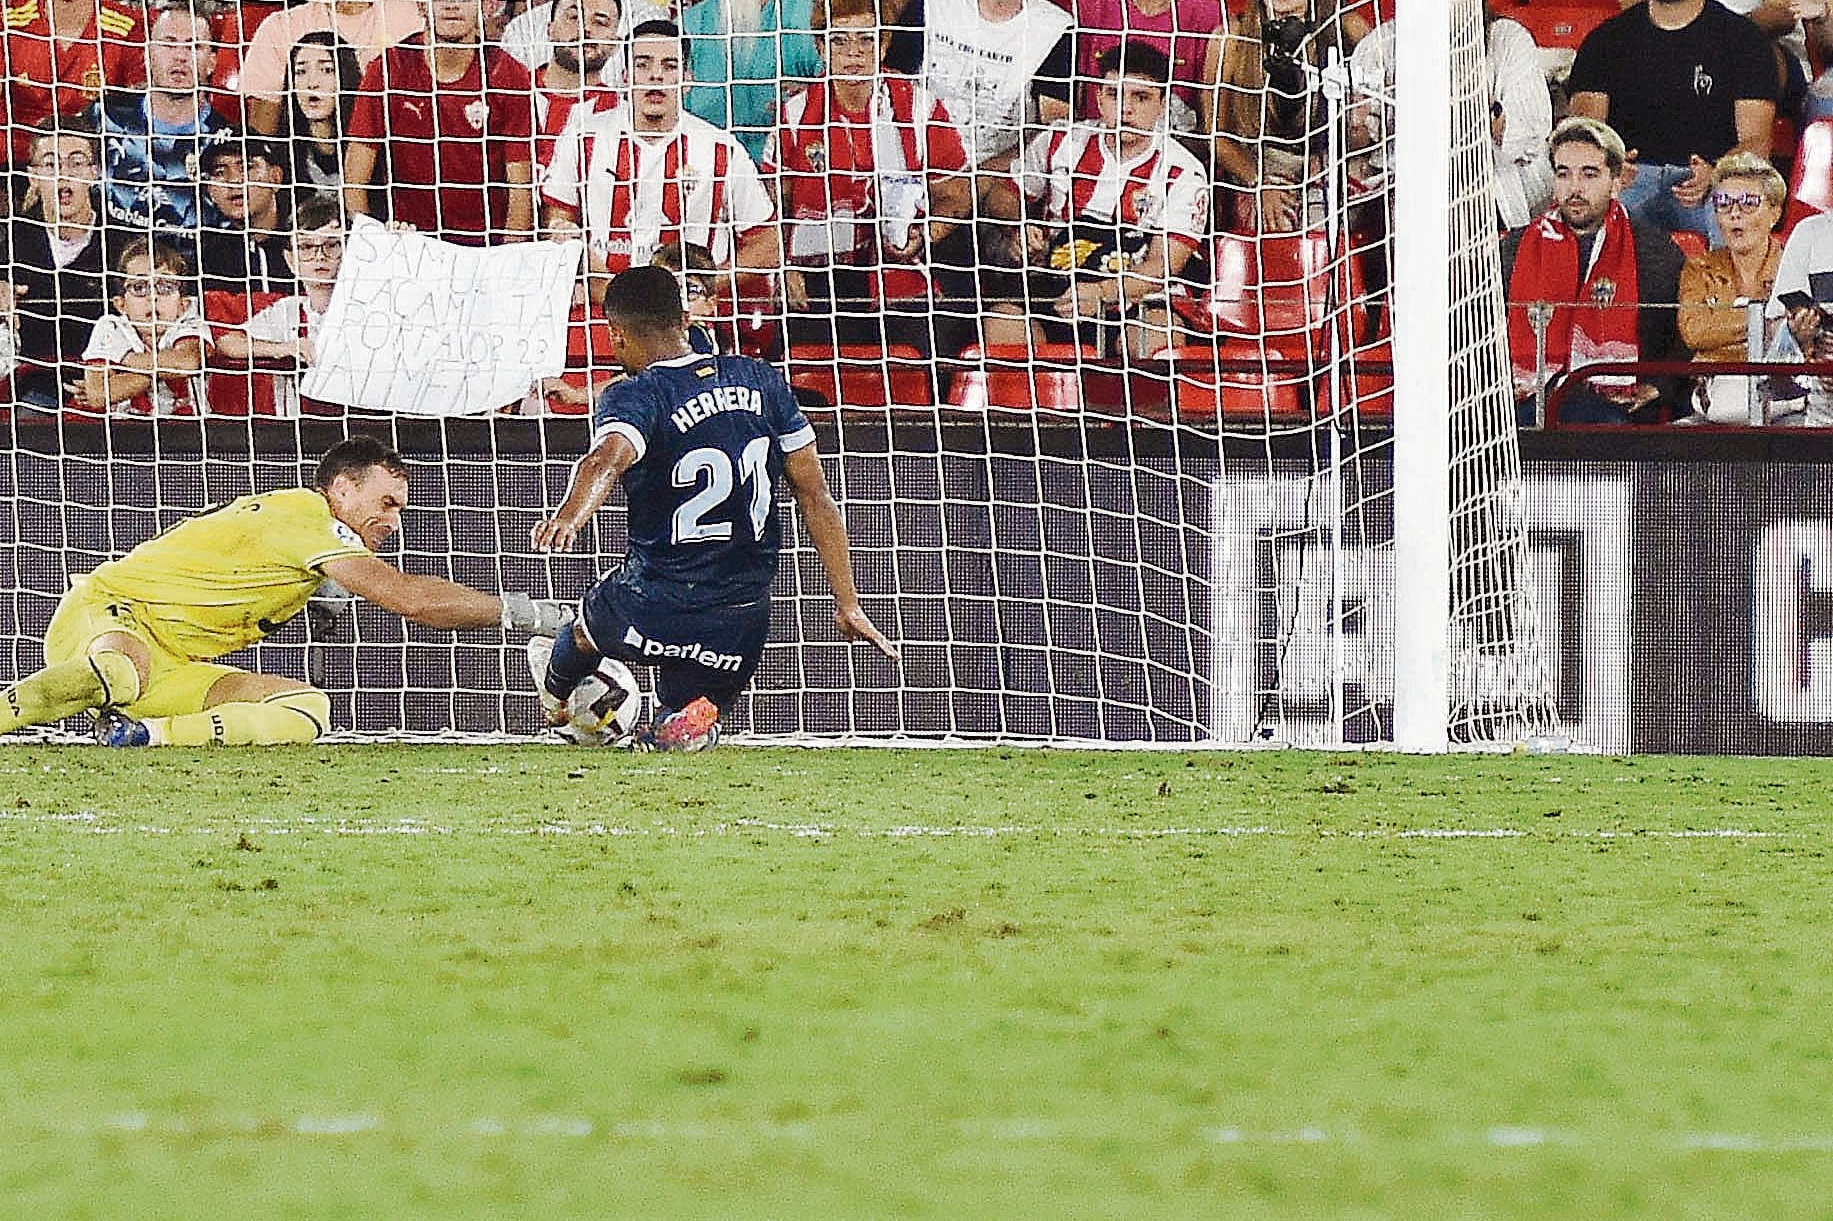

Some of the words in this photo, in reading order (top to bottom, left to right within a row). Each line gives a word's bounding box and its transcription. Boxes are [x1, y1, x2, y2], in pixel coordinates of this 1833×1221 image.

[670, 386, 763, 433] HERRERA
[671, 435, 772, 545] 21
[642, 638, 743, 672] parlem
